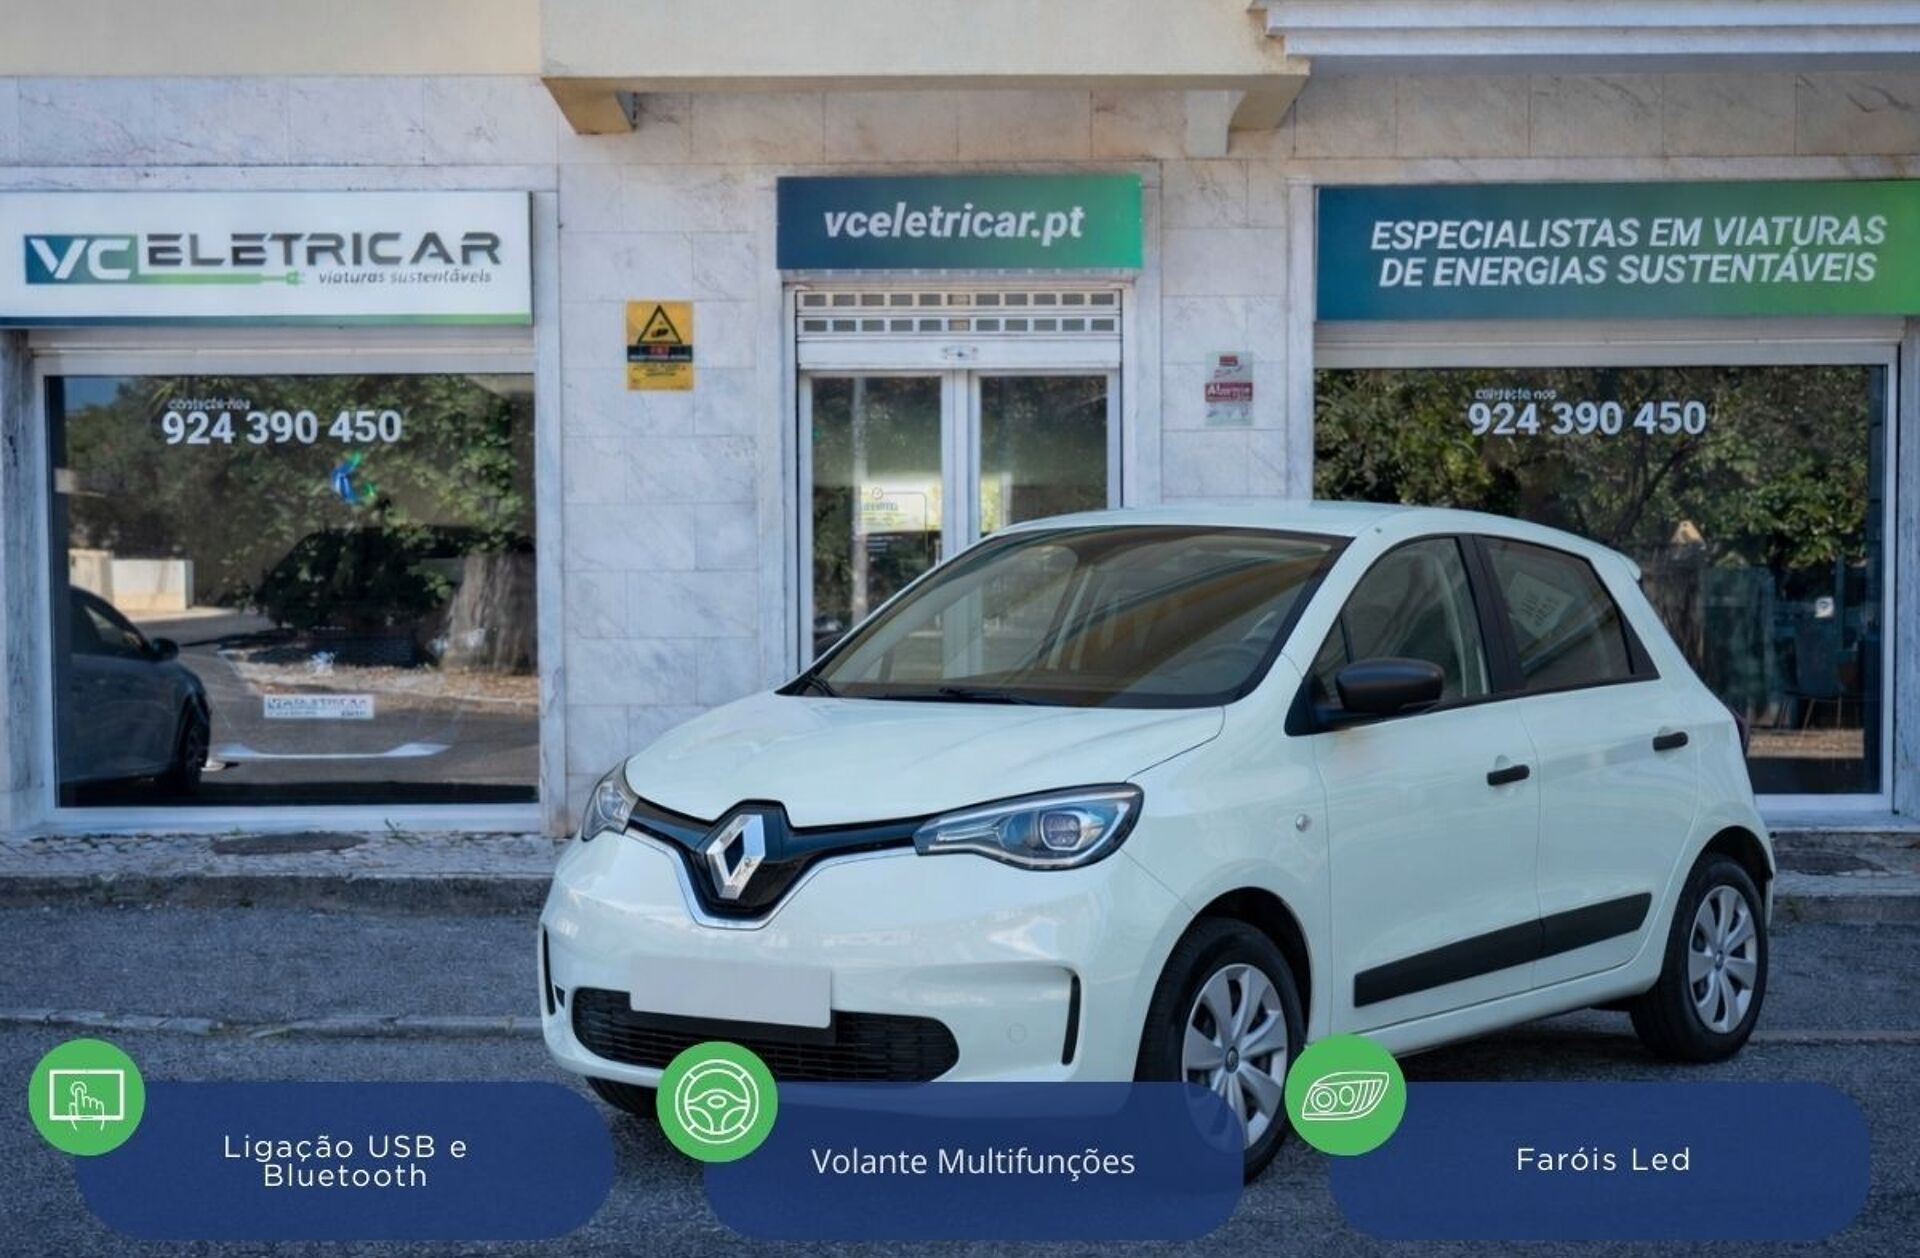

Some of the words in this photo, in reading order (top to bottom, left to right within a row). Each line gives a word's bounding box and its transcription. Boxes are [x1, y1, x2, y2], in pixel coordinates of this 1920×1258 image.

[825, 202, 1085, 246] vceletricar.pt
[1370, 218, 1640, 251] ESPECIALISTAS
[1649, 218, 1702, 247] EM
[1714, 215, 1887, 246] VIATURAS
[318, 270, 386, 285] viaturas
[389, 268, 492, 285] sustentáveis
[1379, 258, 1425, 287] DE
[1433, 255, 1607, 286] ENERGIAS
[1617, 246, 1877, 284] SUSTENTÁVEIS
[162, 410, 236, 445] 924
[246, 410, 318, 444] 390
[328, 409, 402, 444] 450
[1468, 402, 1540, 436] 924
[1550, 401, 1623, 435] 390
[1633, 400, 1707, 435] 450
